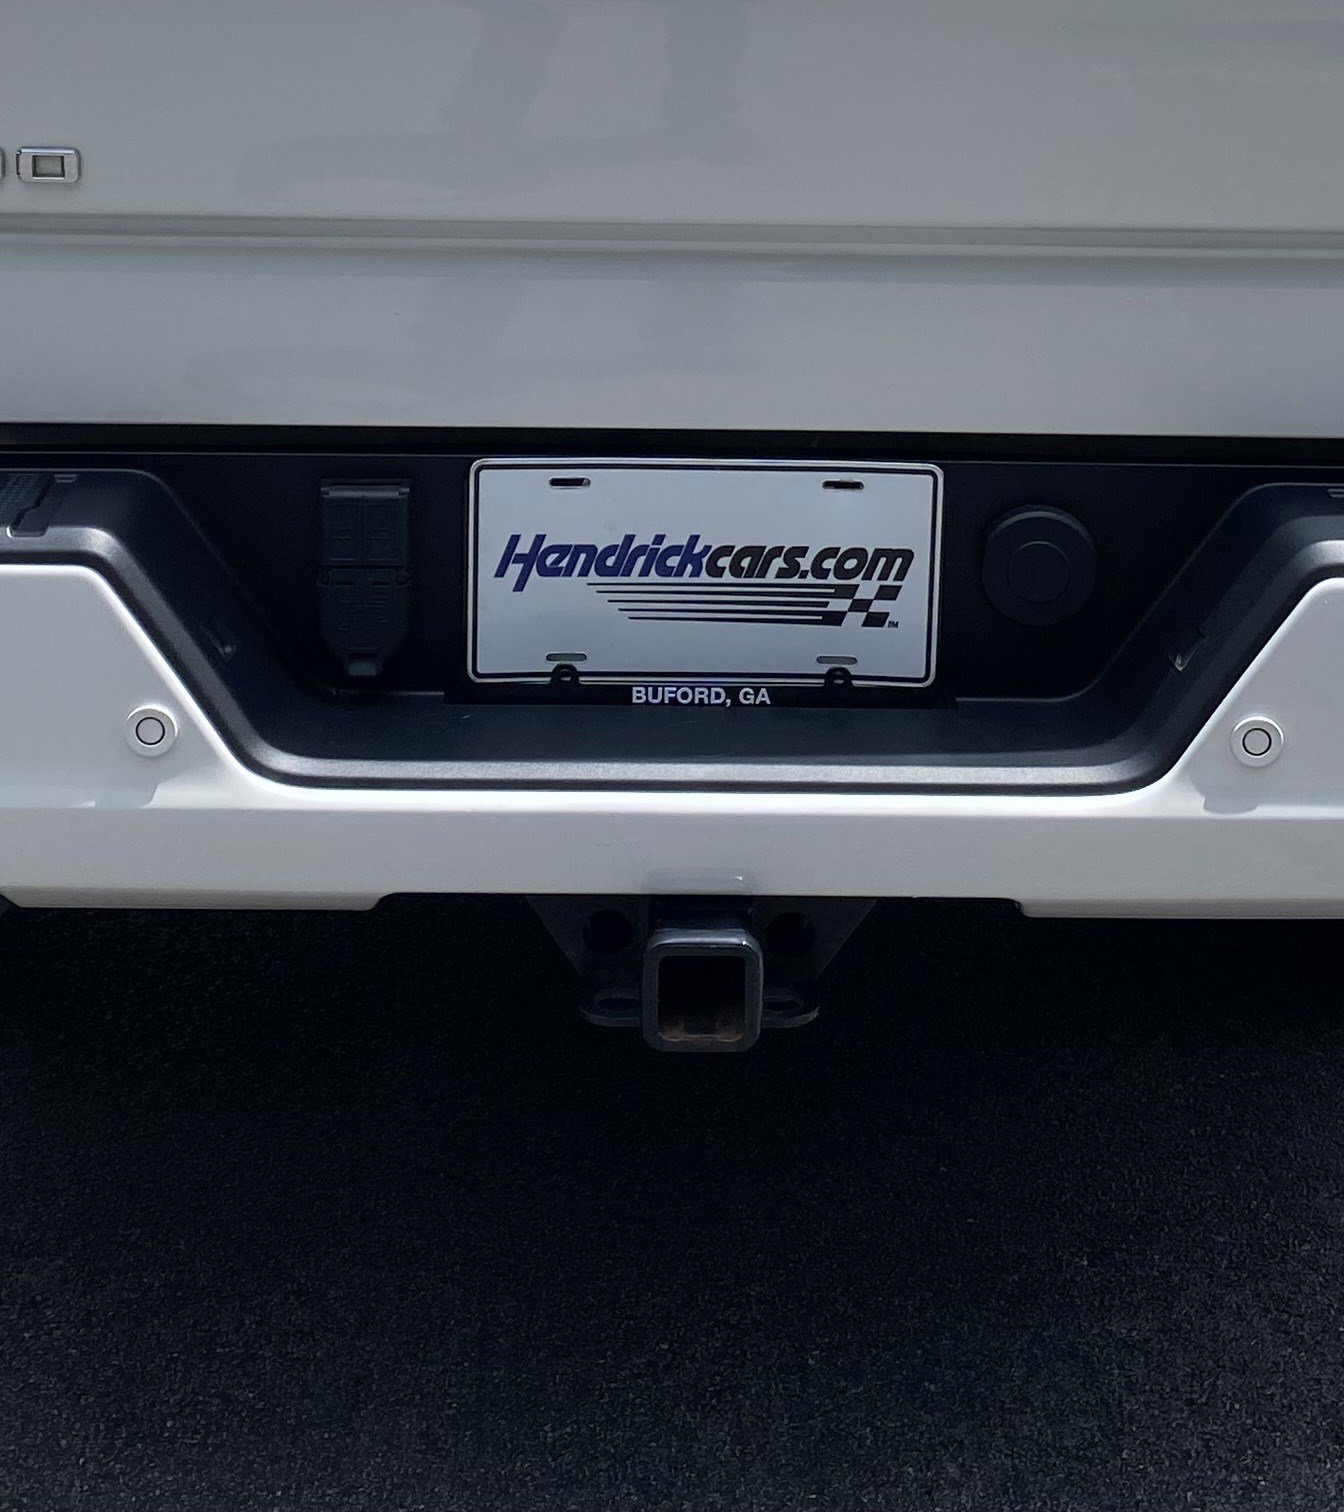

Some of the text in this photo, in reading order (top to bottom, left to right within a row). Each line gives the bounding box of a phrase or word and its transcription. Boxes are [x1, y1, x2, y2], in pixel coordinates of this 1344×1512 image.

[494, 533, 915, 592] Hendrickcars.com
[632, 686, 771, 707] BUFORD, GA
